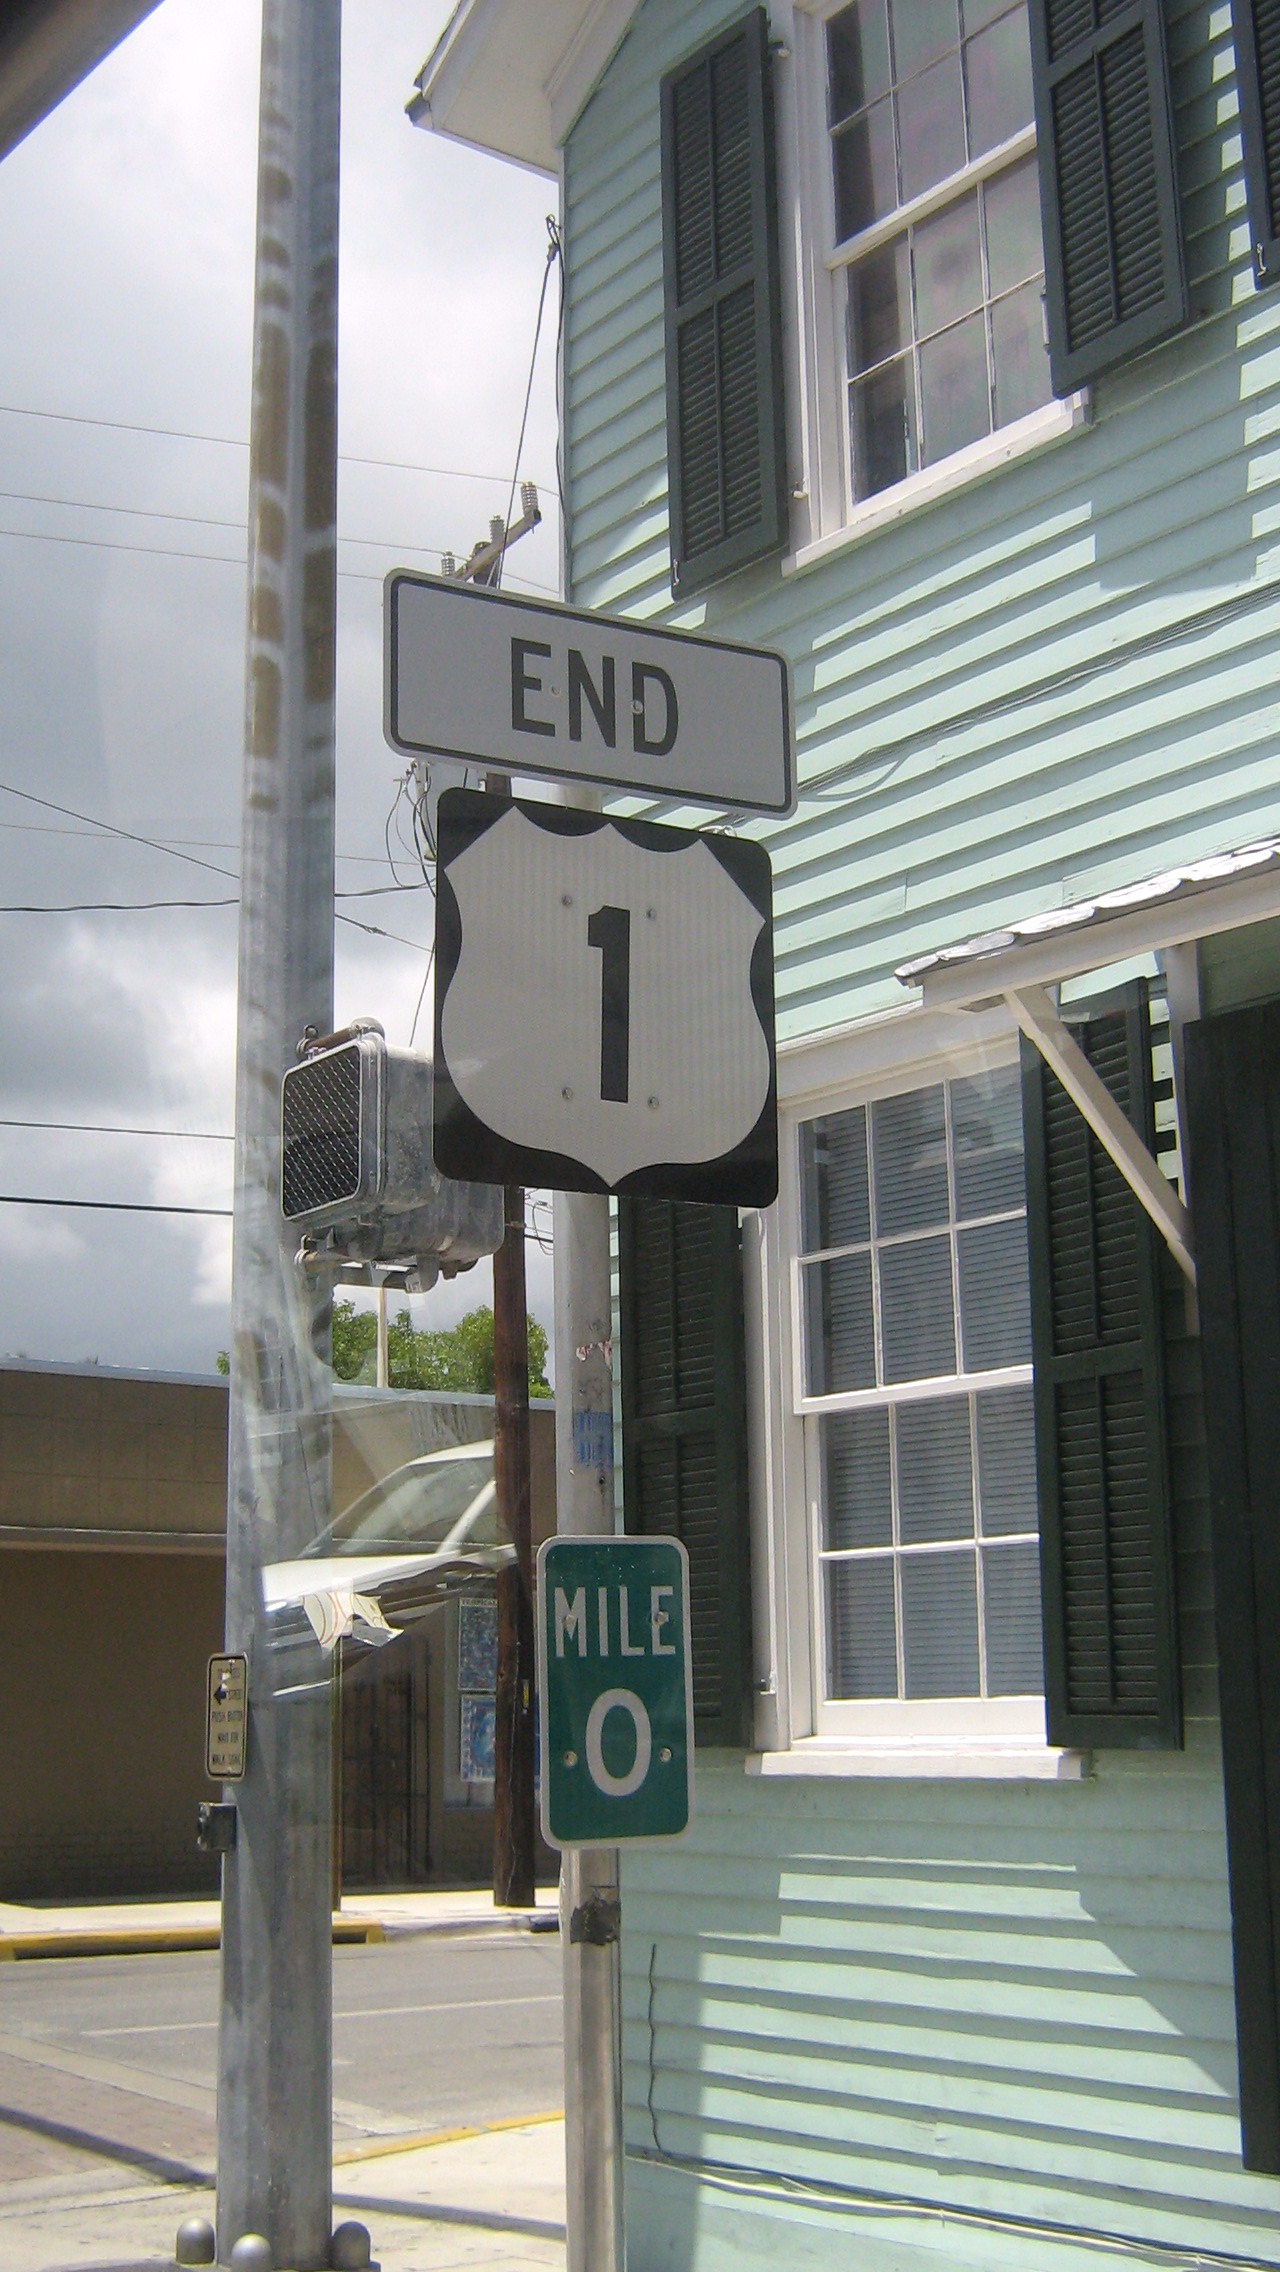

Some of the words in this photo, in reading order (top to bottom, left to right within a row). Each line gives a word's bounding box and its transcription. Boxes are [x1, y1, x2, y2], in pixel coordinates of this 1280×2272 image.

[511, 637, 679, 756] END
[588, 905, 630, 1103] 1
[554, 1585, 676, 1658] MILE
[585, 1688, 652, 1797] 0
